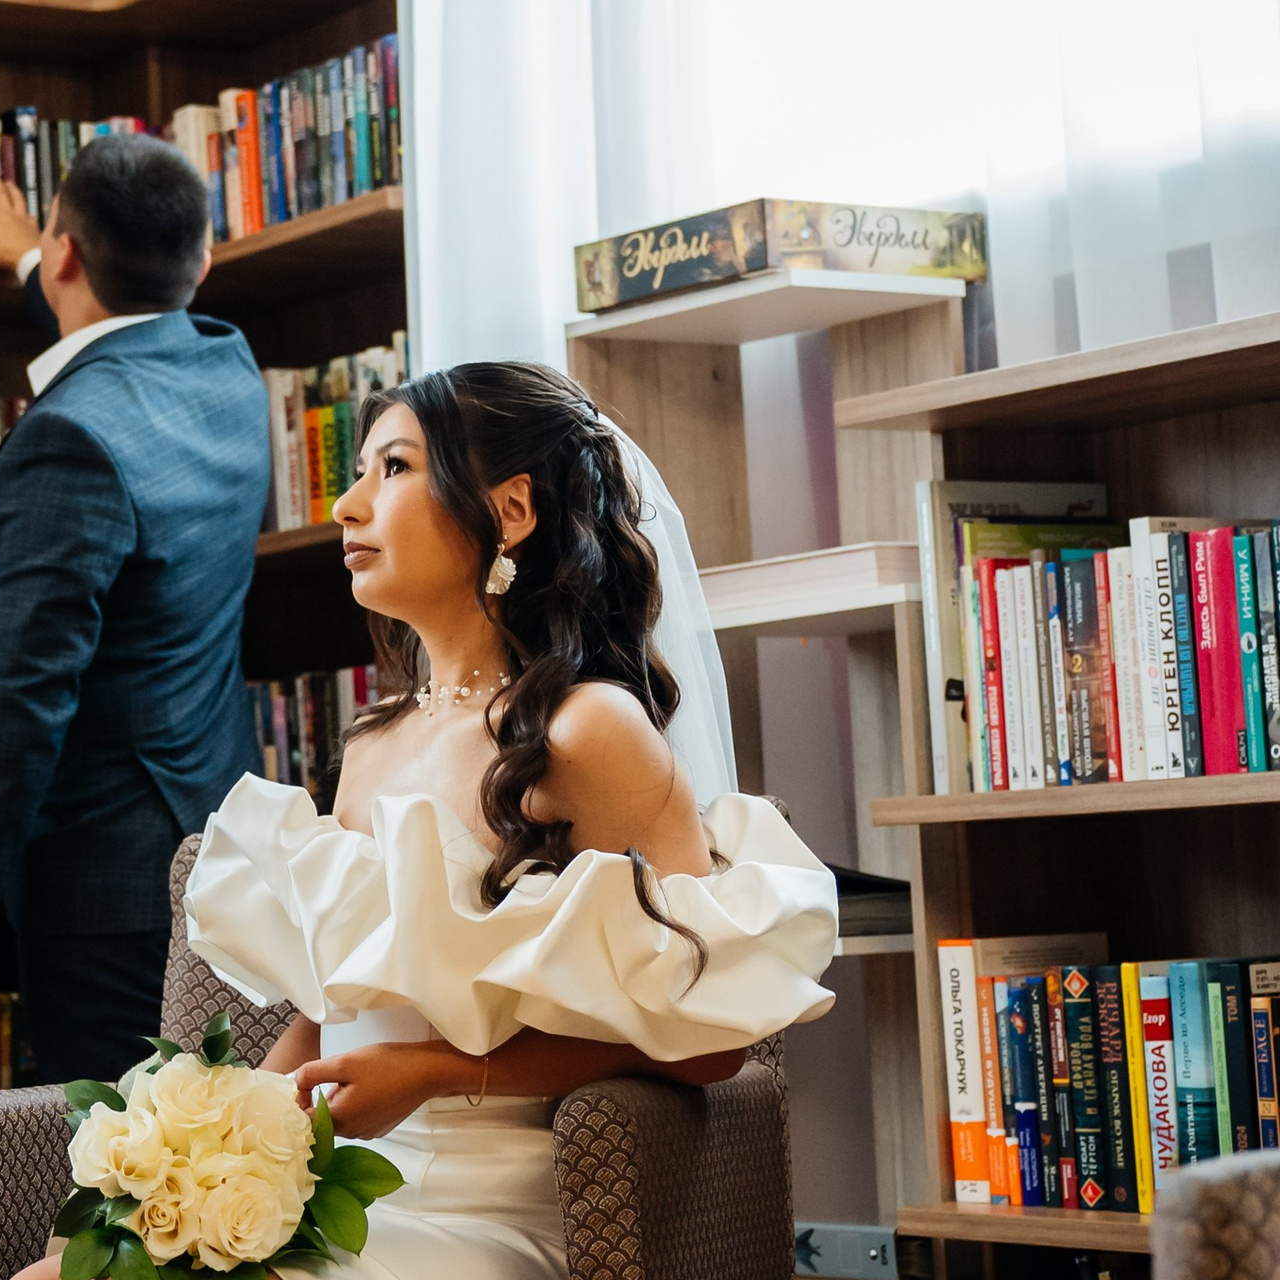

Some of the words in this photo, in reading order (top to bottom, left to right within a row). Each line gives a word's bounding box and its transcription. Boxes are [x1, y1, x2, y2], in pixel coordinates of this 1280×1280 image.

[1194, 541, 1206, 571] Рим
[1238, 548, 1247, 561] У
[1156, 558, 1173, 640] КЛОПП
[1197, 574, 1209, 604] был
[1239, 563, 1253, 619] МИН-И
[1199, 606, 1212, 650] Здесь
[1071, 653, 1083, 673] 2
[1161, 650, 1180, 732] ЮРГЕН
[949, 968, 962, 1016] ОЛЬГА
[1226, 998, 1238, 1024] ТОМ
[1032, 1004, 1042, 1055] ПОРТРЕТ
[1106, 981, 1124, 1064] РИЧАРД
[952, 1019, 968, 1096] ТОКАРЧУК
[981, 1006, 991, 1054] НОВОЕ
[986, 1058, 997, 1129] БУДУЩЕЕ
[1110, 1070, 1121, 1117] ОГАРОК
[1152, 1044, 1176, 1171] ЧУДАКОВА
[1112, 1120, 1122, 1136] ВО
[1183, 1093, 1197, 1151] Ройтман
[1079, 1135, 1089, 1176] СТЮАРТ
[1114, 1139, 1125, 1169] ТЬМЕ
